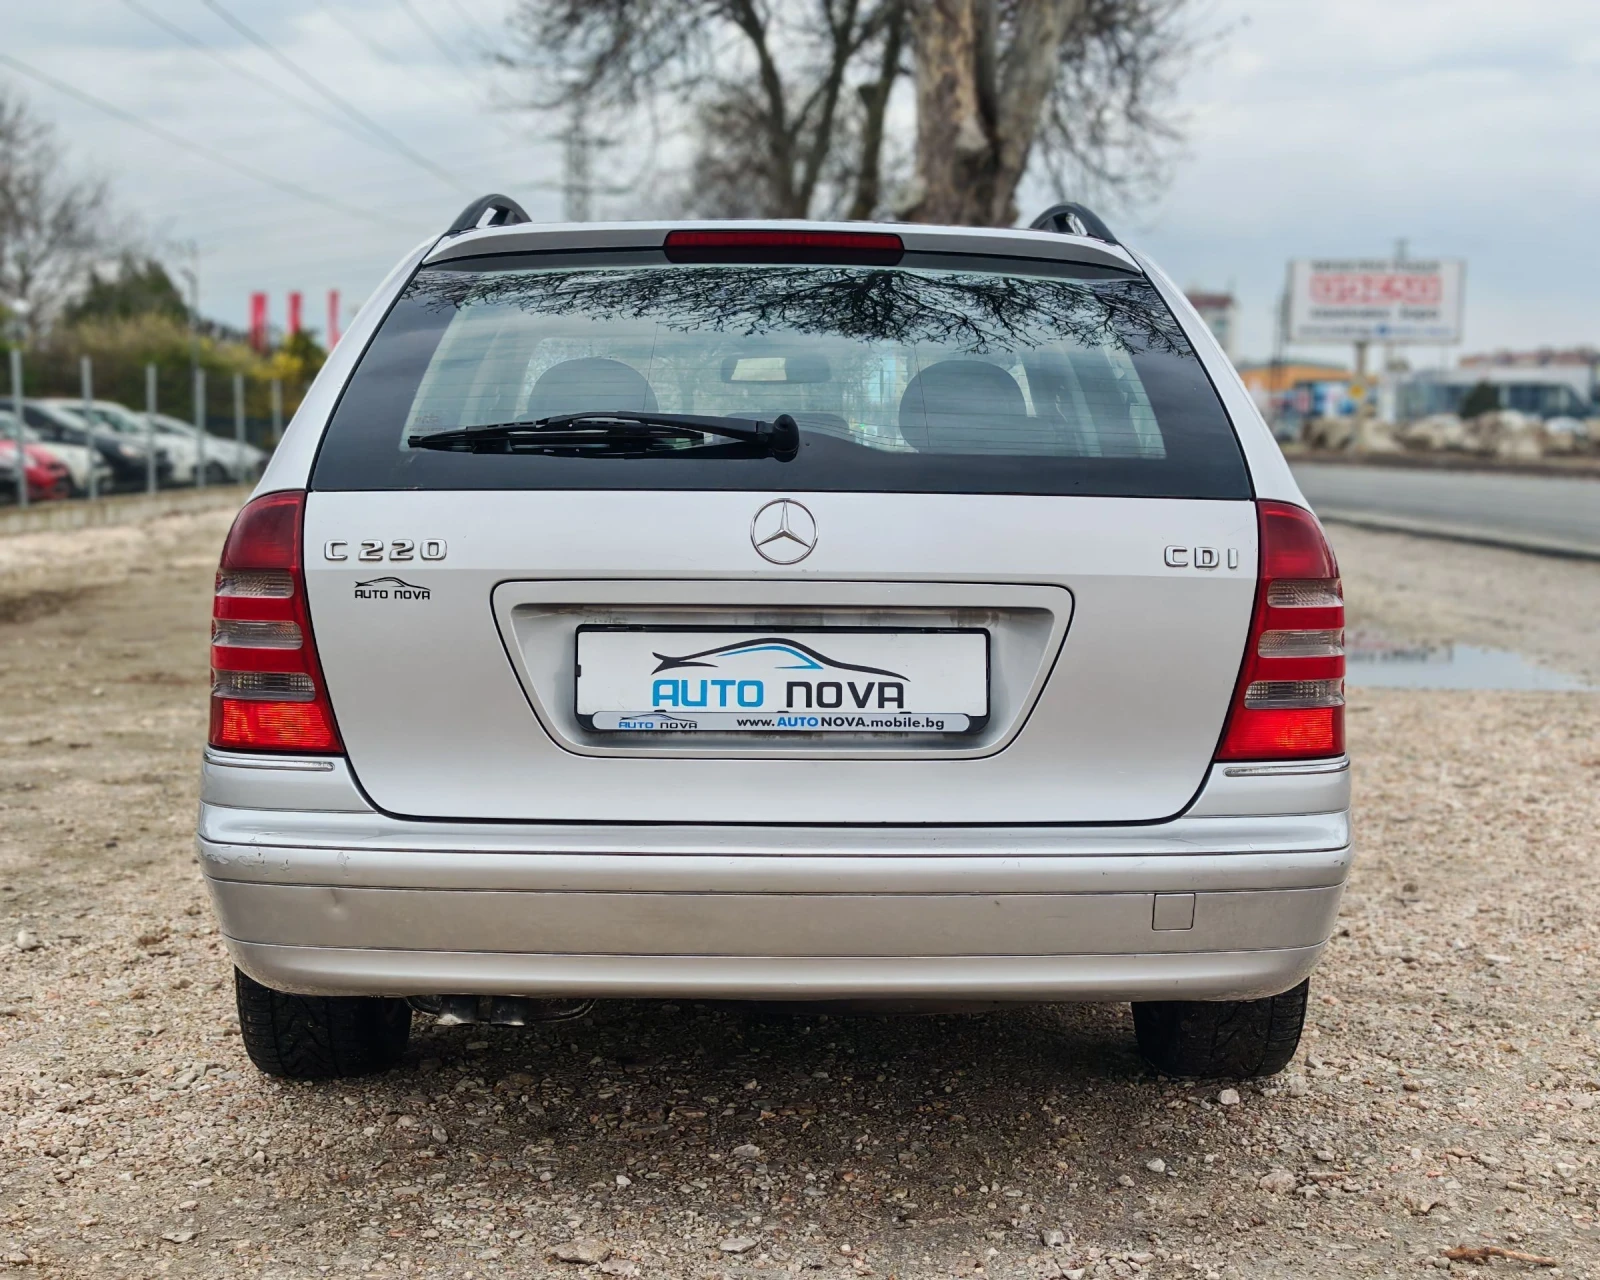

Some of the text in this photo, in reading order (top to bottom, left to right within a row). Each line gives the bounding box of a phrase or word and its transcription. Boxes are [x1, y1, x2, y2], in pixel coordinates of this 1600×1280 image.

[324, 538, 448, 561] C 220
[1164, 545, 1239, 569] CDI
[354, 589, 431, 600] AUTO NOVA
[652, 679, 904, 709] AUTO NOVA
[618, 721, 698, 729] AUTO NOVA
[736, 716, 945, 730] www.AUTONOVA.mobile.bg
